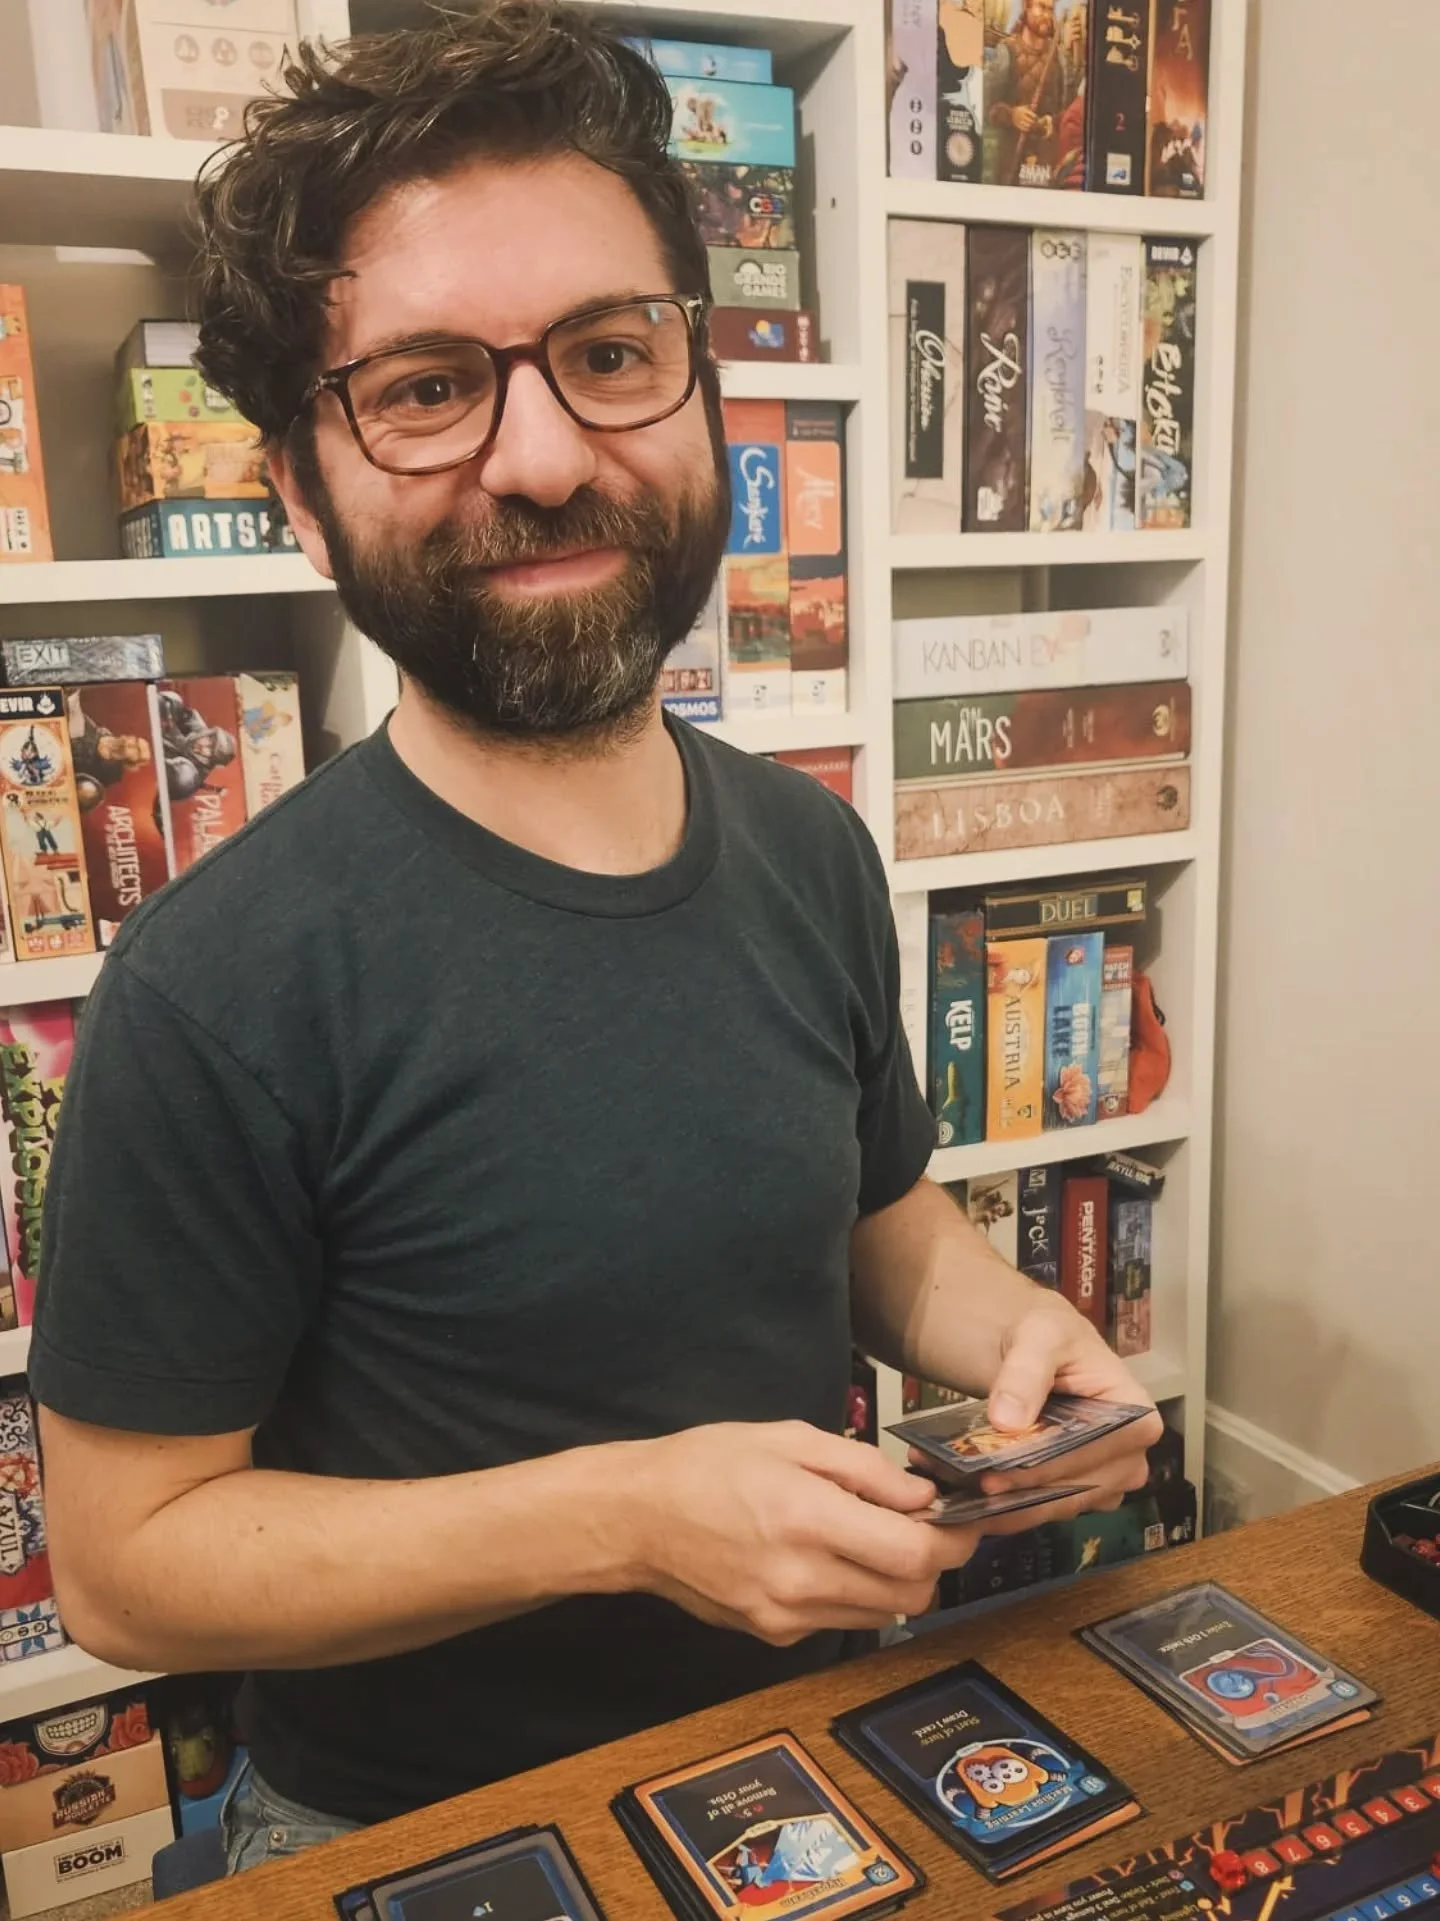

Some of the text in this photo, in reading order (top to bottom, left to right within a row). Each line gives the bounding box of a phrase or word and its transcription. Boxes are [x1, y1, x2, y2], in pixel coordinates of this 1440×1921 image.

[16, 643, 70, 668] EXIT
[922, 636, 1022, 675] KANBAN
[0, 697, 33, 714] EVIR
[930, 715, 1013, 765] MARS
[194, 793, 227, 858] PALA
[932, 794, 1067, 840] LISBOA
[107, 805, 142, 906] ARCHITECTS
[1041, 897, 1097, 923] DUEL
[945, 999, 976, 1051] KELP
[1004, 994, 1022, 1091] AUSTRIA
[1053, 1005, 1071, 1058] LAKE
[1080, 1200, 1095, 1298] PENTAGO
[57, 1844, 124, 1875] BOOM
[1254, 1796, 1420, 1875] 3 4 5 6 7 8
[1374, 1882, 1437, 1919] 5 6 7
